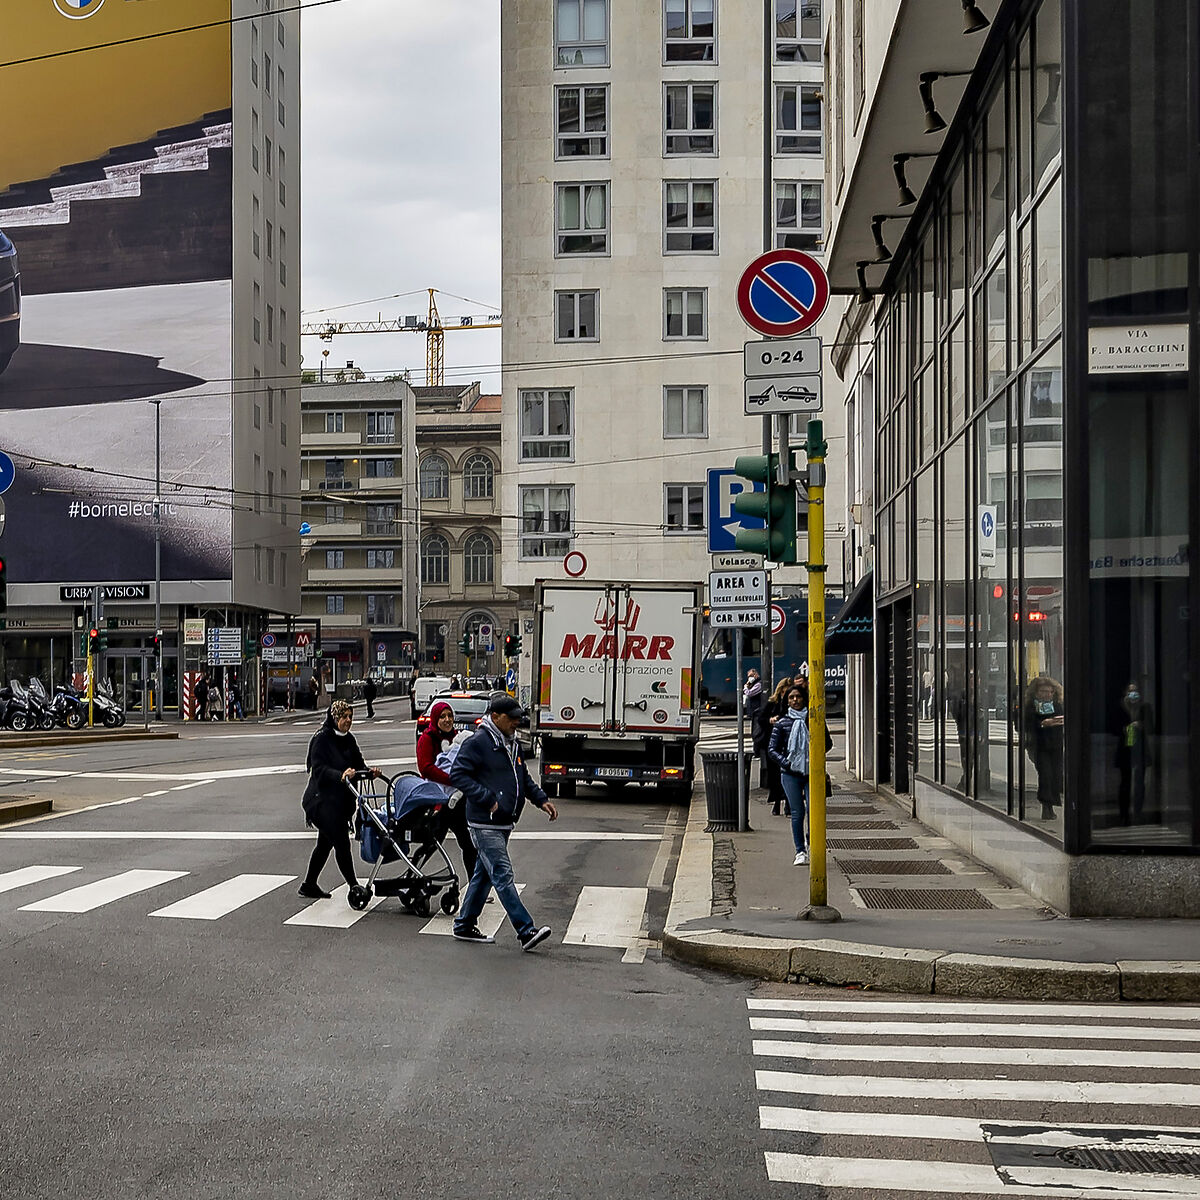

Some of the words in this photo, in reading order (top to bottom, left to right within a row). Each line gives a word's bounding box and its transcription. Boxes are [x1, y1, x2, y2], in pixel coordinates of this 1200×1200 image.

[1128, 329, 1148, 338] VIA
[1091, 346, 1101, 355] F.
[1108, 343, 1185, 354] BARACCHINI
[761, 350, 804, 365] 0-24
[719, 474, 755, 519] P
[720, 557, 756, 566] Velasca
[717, 577, 745, 589] AREA
[752, 576, 760, 587] C
[65, 588, 93, 598] URBA
[106, 586, 145, 597] VISION
[716, 614, 732, 623] CAR
[738, 613, 761, 623] WASH
[560, 634, 675, 660] MARR
[558, 663, 585, 673] dove
[588, 663, 604, 674] c'è
[608, 665, 673, 676] rstorazione
